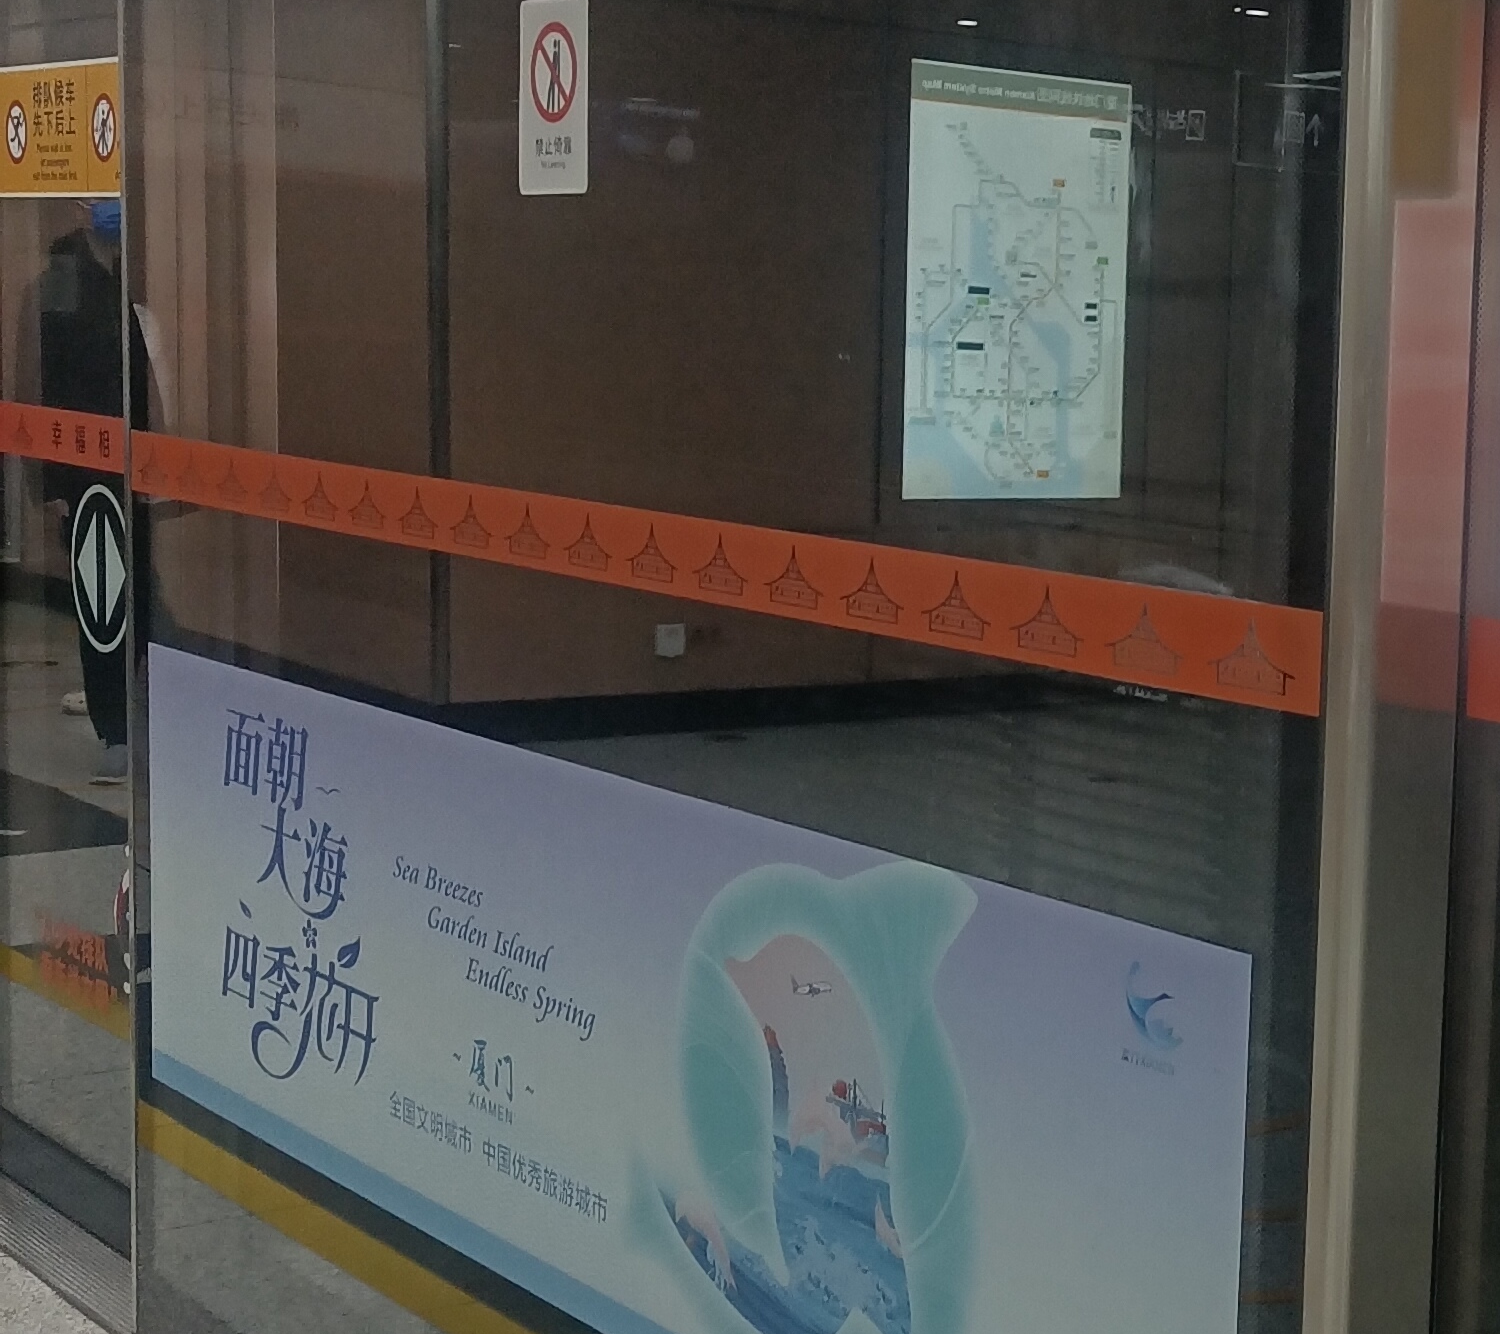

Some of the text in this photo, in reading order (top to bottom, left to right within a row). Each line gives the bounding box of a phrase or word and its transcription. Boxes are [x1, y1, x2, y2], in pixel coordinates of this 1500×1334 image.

[33, 109, 77, 137] 先下后上
[224, 708, 308, 811] 面朝
[256, 804, 349, 920] 大海
[393, 855, 484, 908] Sea Breezes
[427, 906, 554, 973] Garden Island
[465, 957, 596, 1042] Endless Spring
[469, 1039, 514, 1103] 厦门
[468, 1091, 513, 1126] XIAMEN
[389, 1090, 608, 1223] 全国文明城市 中国优秀旅游城市
